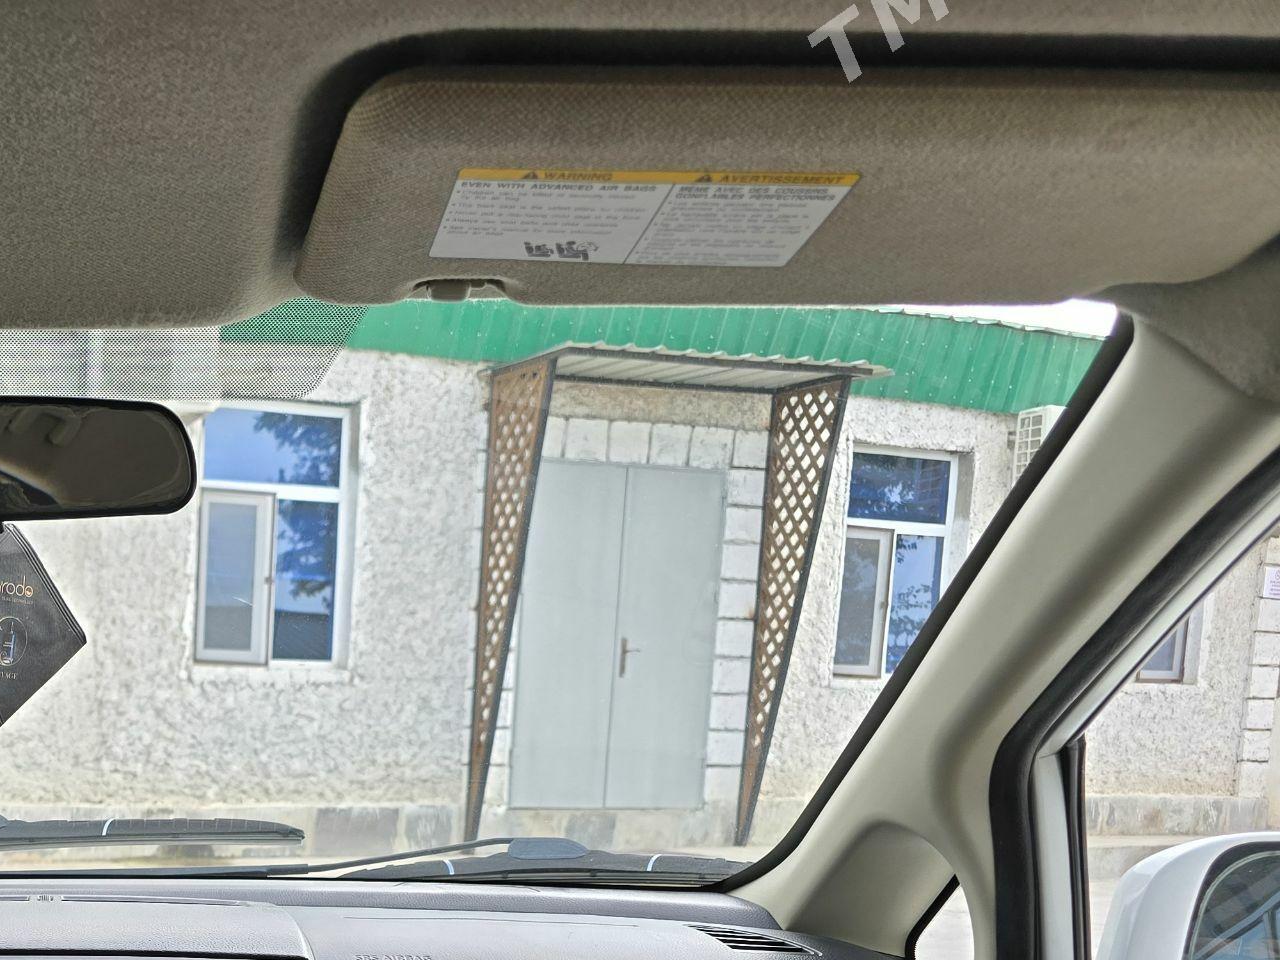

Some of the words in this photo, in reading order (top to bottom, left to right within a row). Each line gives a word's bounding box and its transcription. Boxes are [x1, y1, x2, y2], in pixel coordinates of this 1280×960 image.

[543, 171, 613, 181] WARNING
[719, 174, 846, 185] AVERTISSEMENT
[460, 181, 492, 189] EVEN
[496, 182, 526, 190] WITH
[530, 184, 593, 192] ADVANCED
